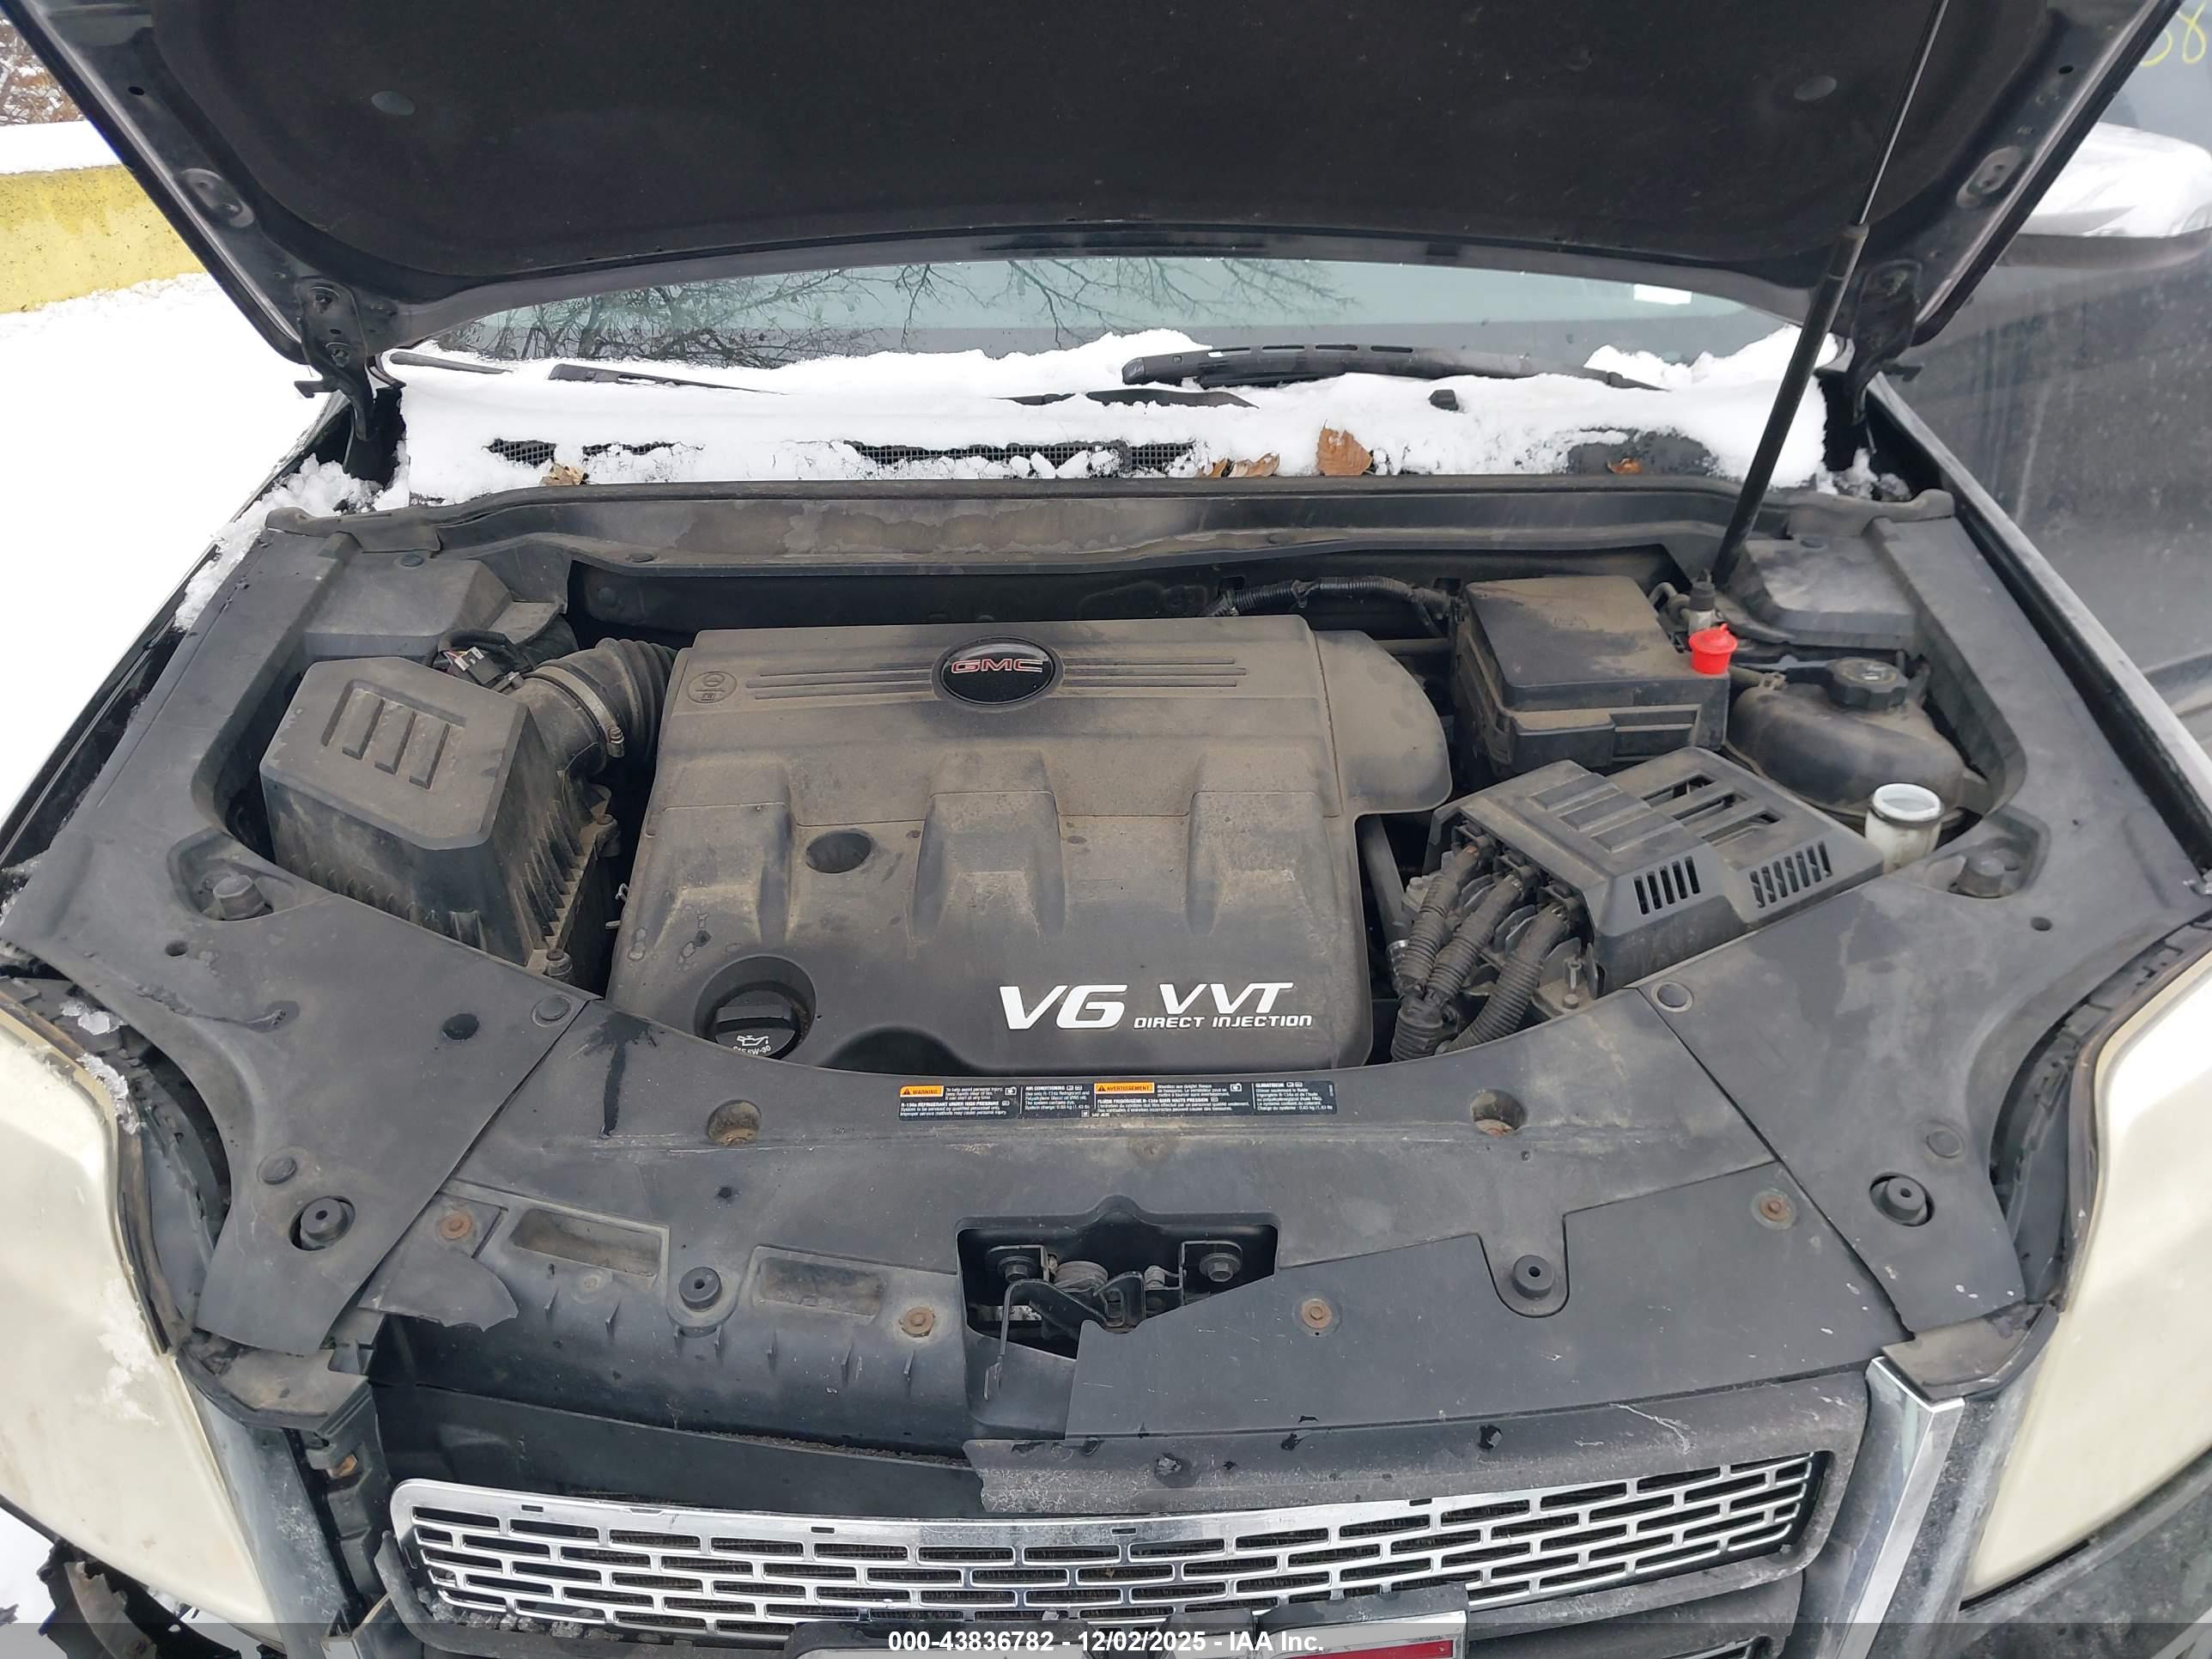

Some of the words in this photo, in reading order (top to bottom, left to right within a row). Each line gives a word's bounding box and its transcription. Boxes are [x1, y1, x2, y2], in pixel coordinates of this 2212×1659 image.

[951, 659, 1043, 673] GMC
[999, 984, 1127, 1030] V6
[1159, 982, 1294, 1014] VVT
[1133, 1017, 1206, 1029] DIRECT
[1212, 1015, 1313, 1028] INJECTION
